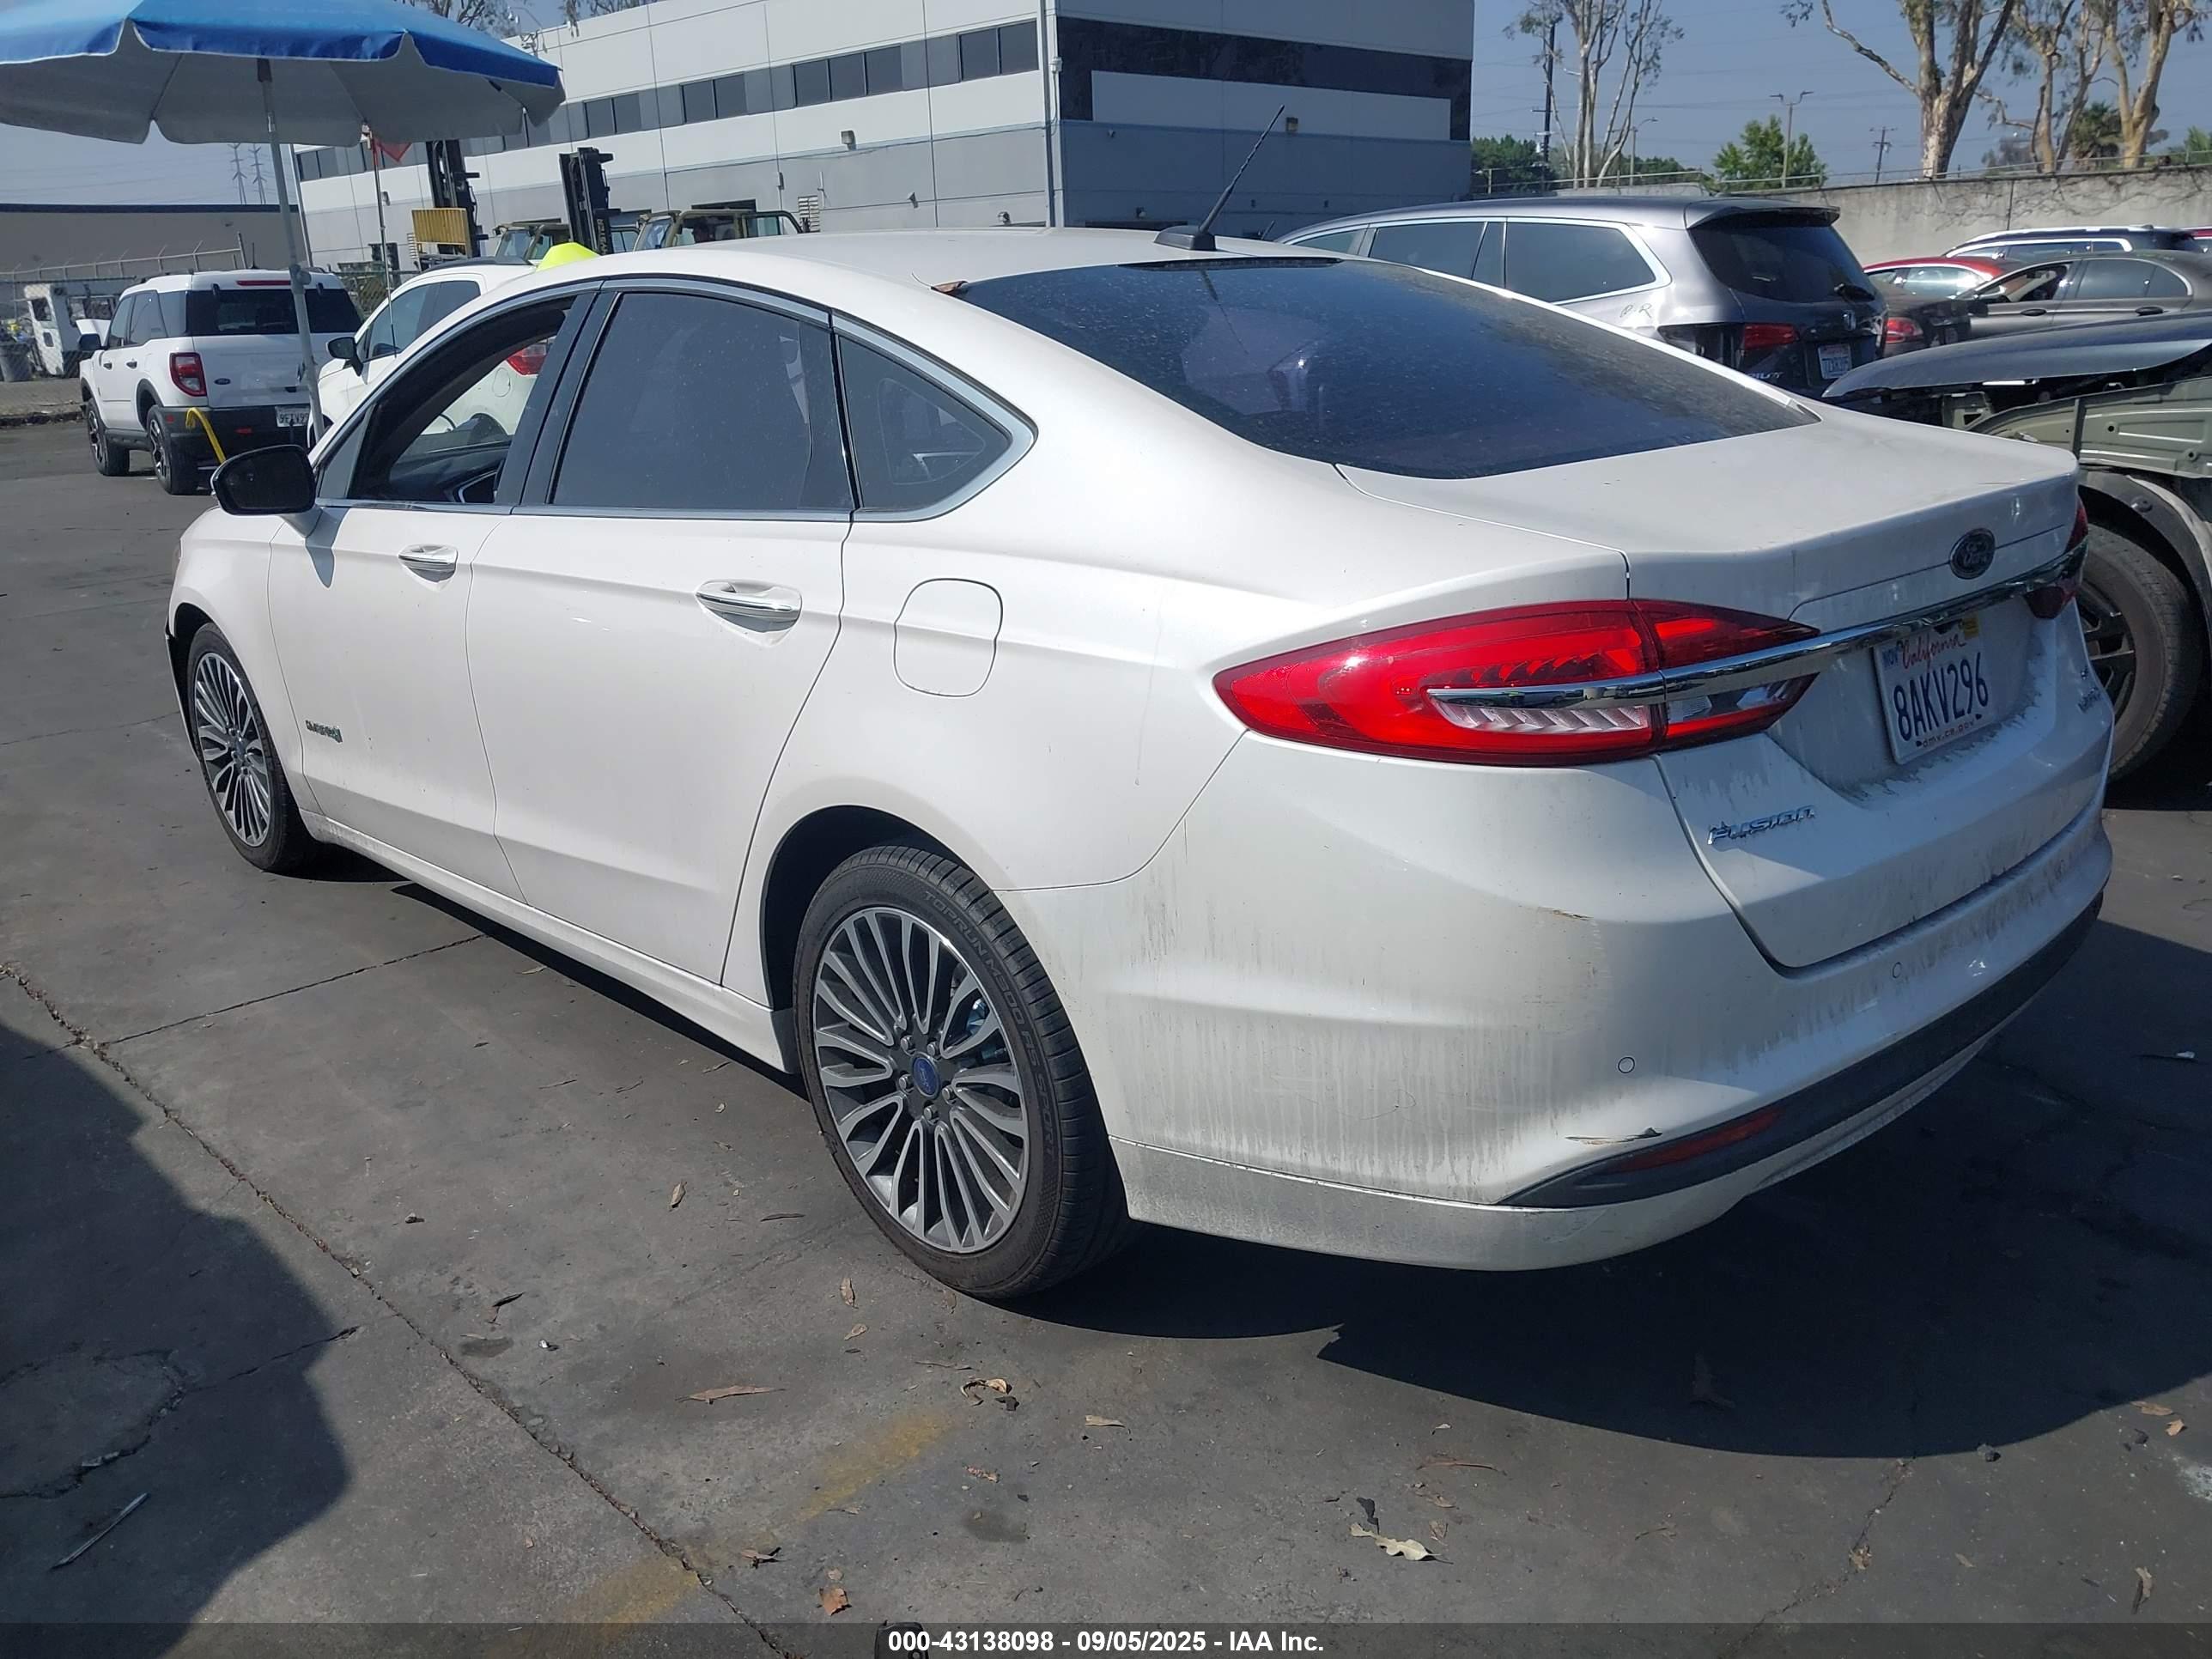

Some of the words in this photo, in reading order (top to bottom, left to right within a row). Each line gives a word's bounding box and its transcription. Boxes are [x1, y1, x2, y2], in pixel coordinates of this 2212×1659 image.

[1902, 633, 1967, 670] California
[1893, 651, 1989, 742] 8AKV296
[923, 890, 989, 957] TOPRUN
